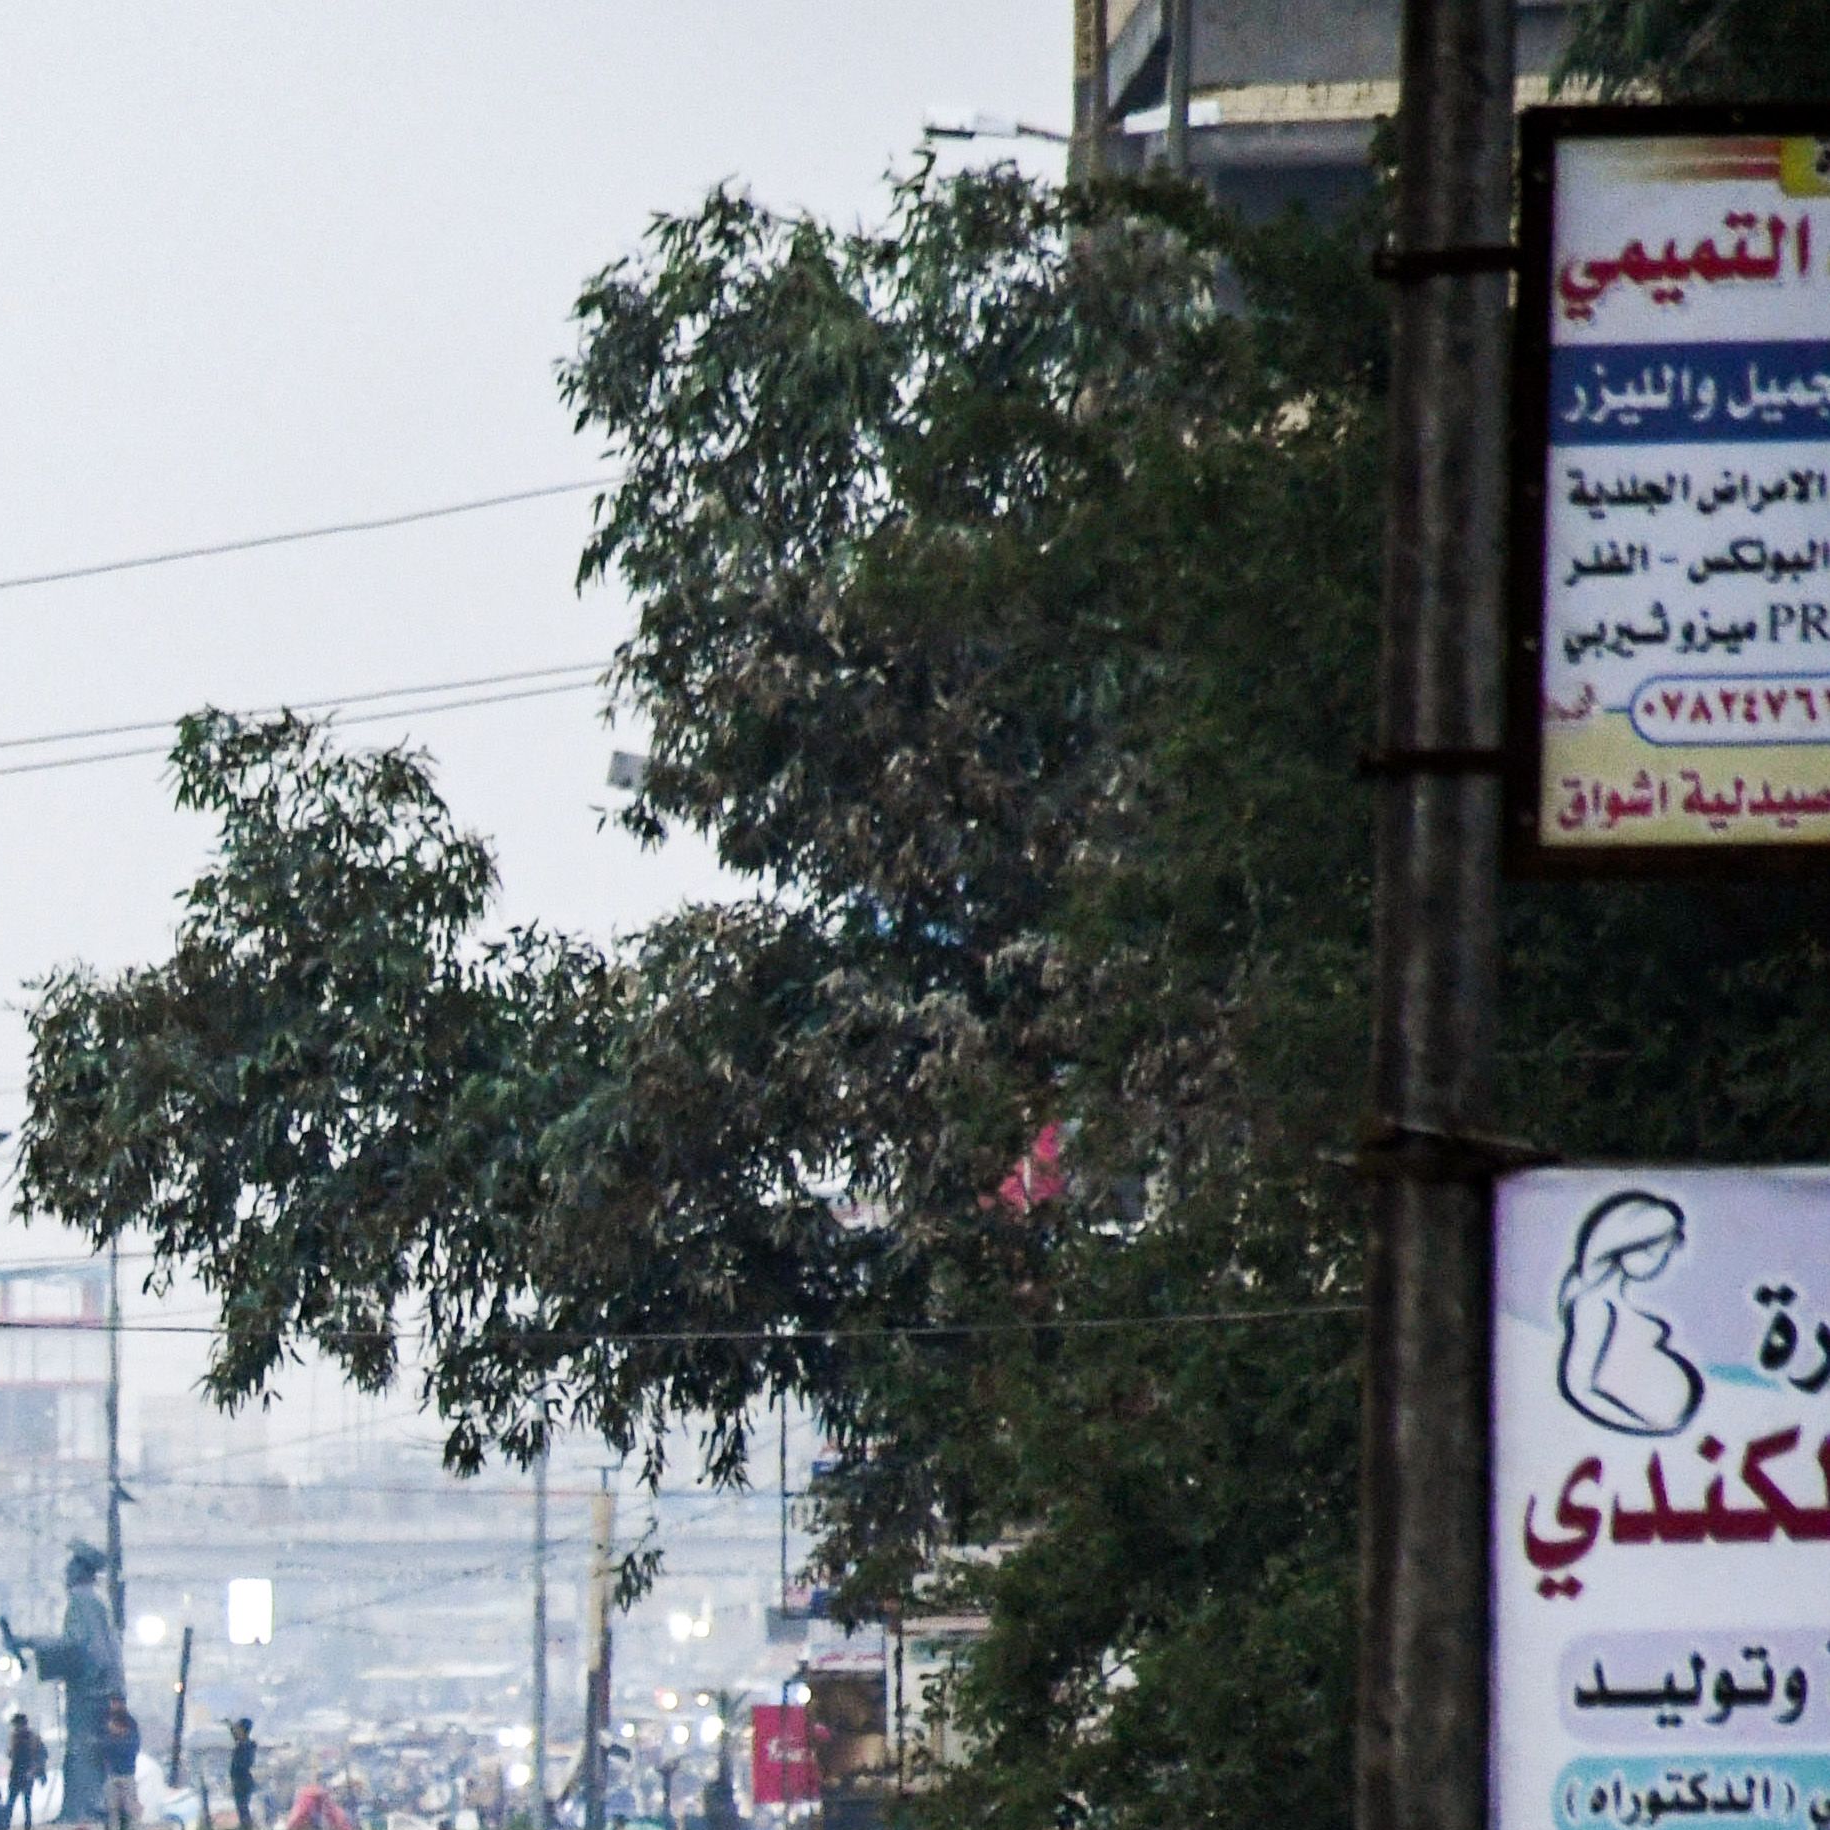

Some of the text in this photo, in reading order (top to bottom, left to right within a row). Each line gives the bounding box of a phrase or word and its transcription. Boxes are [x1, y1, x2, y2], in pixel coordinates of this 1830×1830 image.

[1560, 210, 1811, 322] التميمي
[1563, 364, 1715, 425] والليزر
[1567, 468, 1691, 520] الجلدية
[1565, 540, 1650, 586] الفلر
[1574, 1645, 1807, 1728] وتوليد
